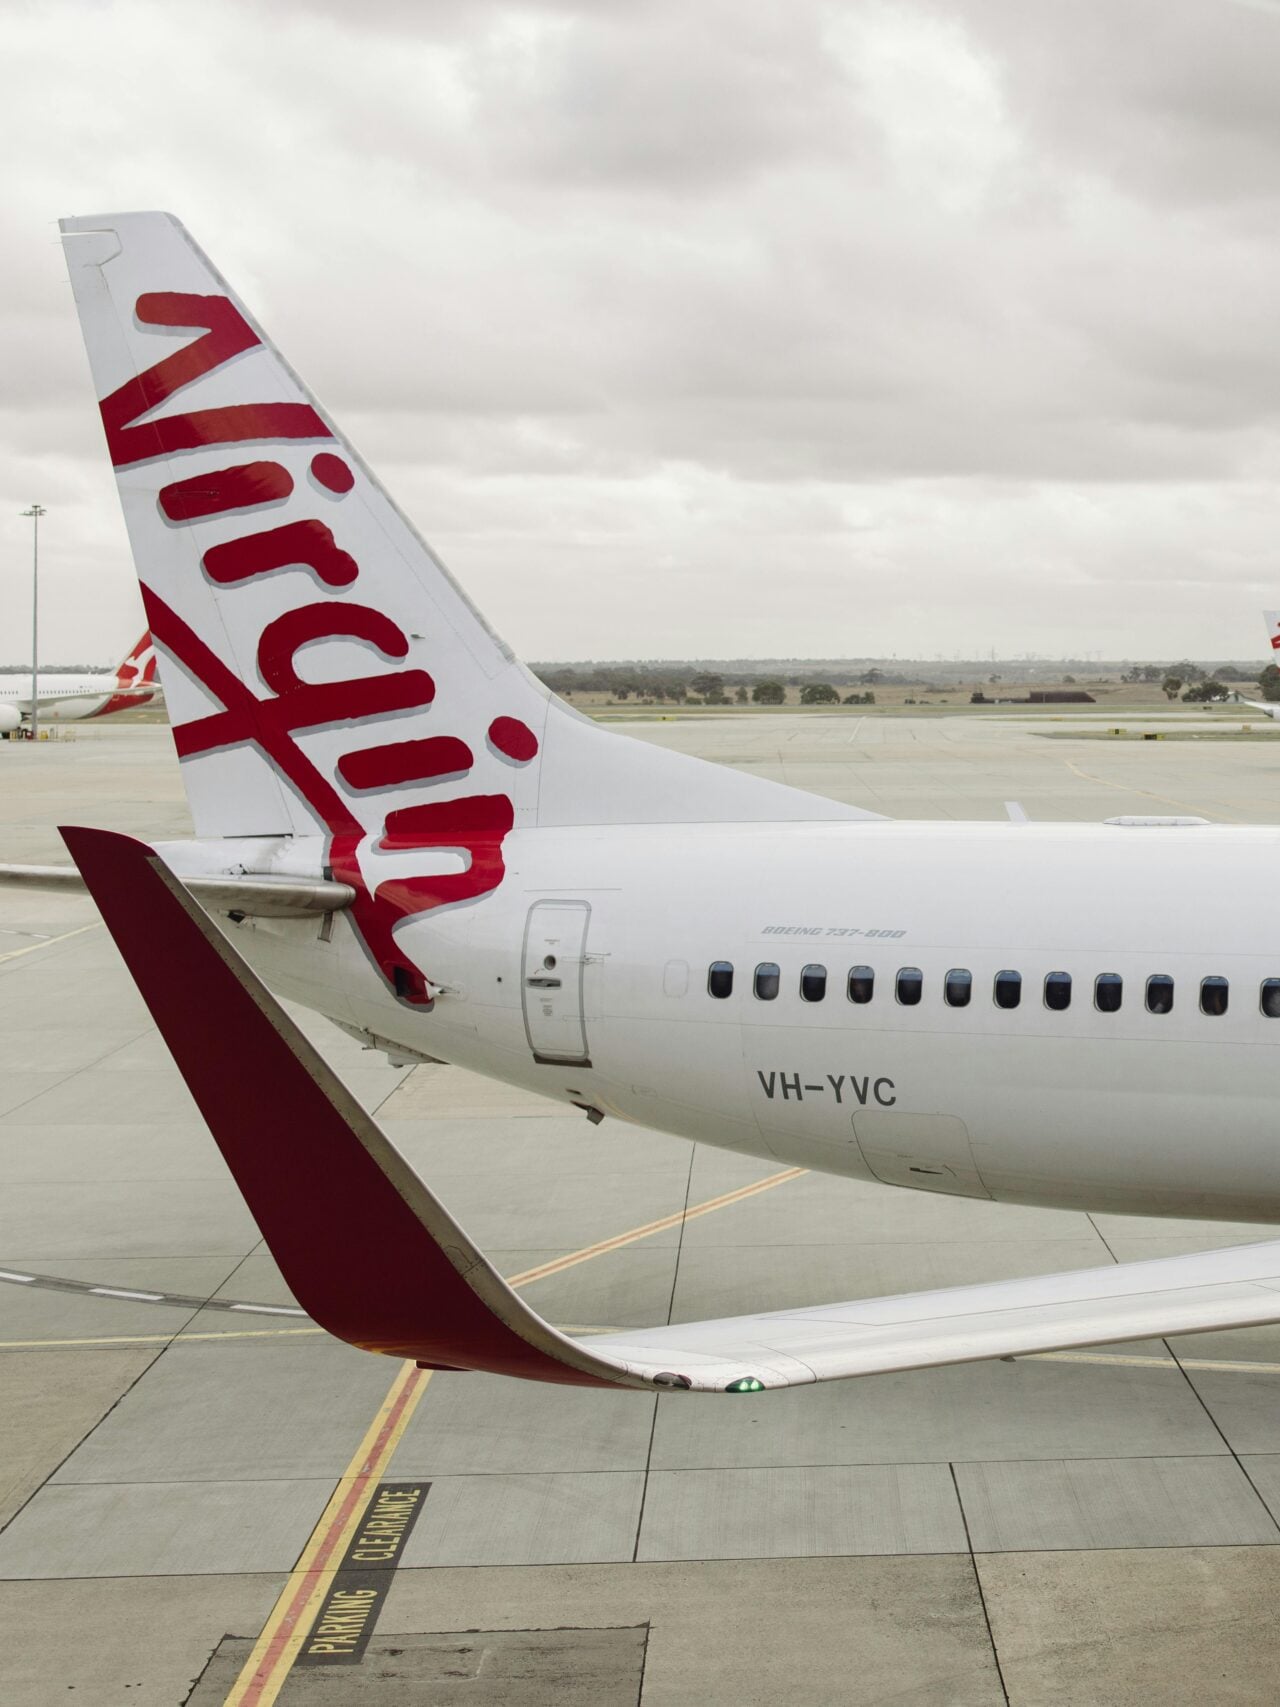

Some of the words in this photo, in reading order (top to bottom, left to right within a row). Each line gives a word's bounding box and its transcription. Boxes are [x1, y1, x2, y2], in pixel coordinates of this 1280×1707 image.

[761, 926, 823, 936] BOEING
[825, 928, 907, 938] 737-800
[757, 1070, 897, 1107] VH-YVC
[308, 1589, 378, 1655] PARKING
[351, 1488, 421, 1562] CLEARANCE
